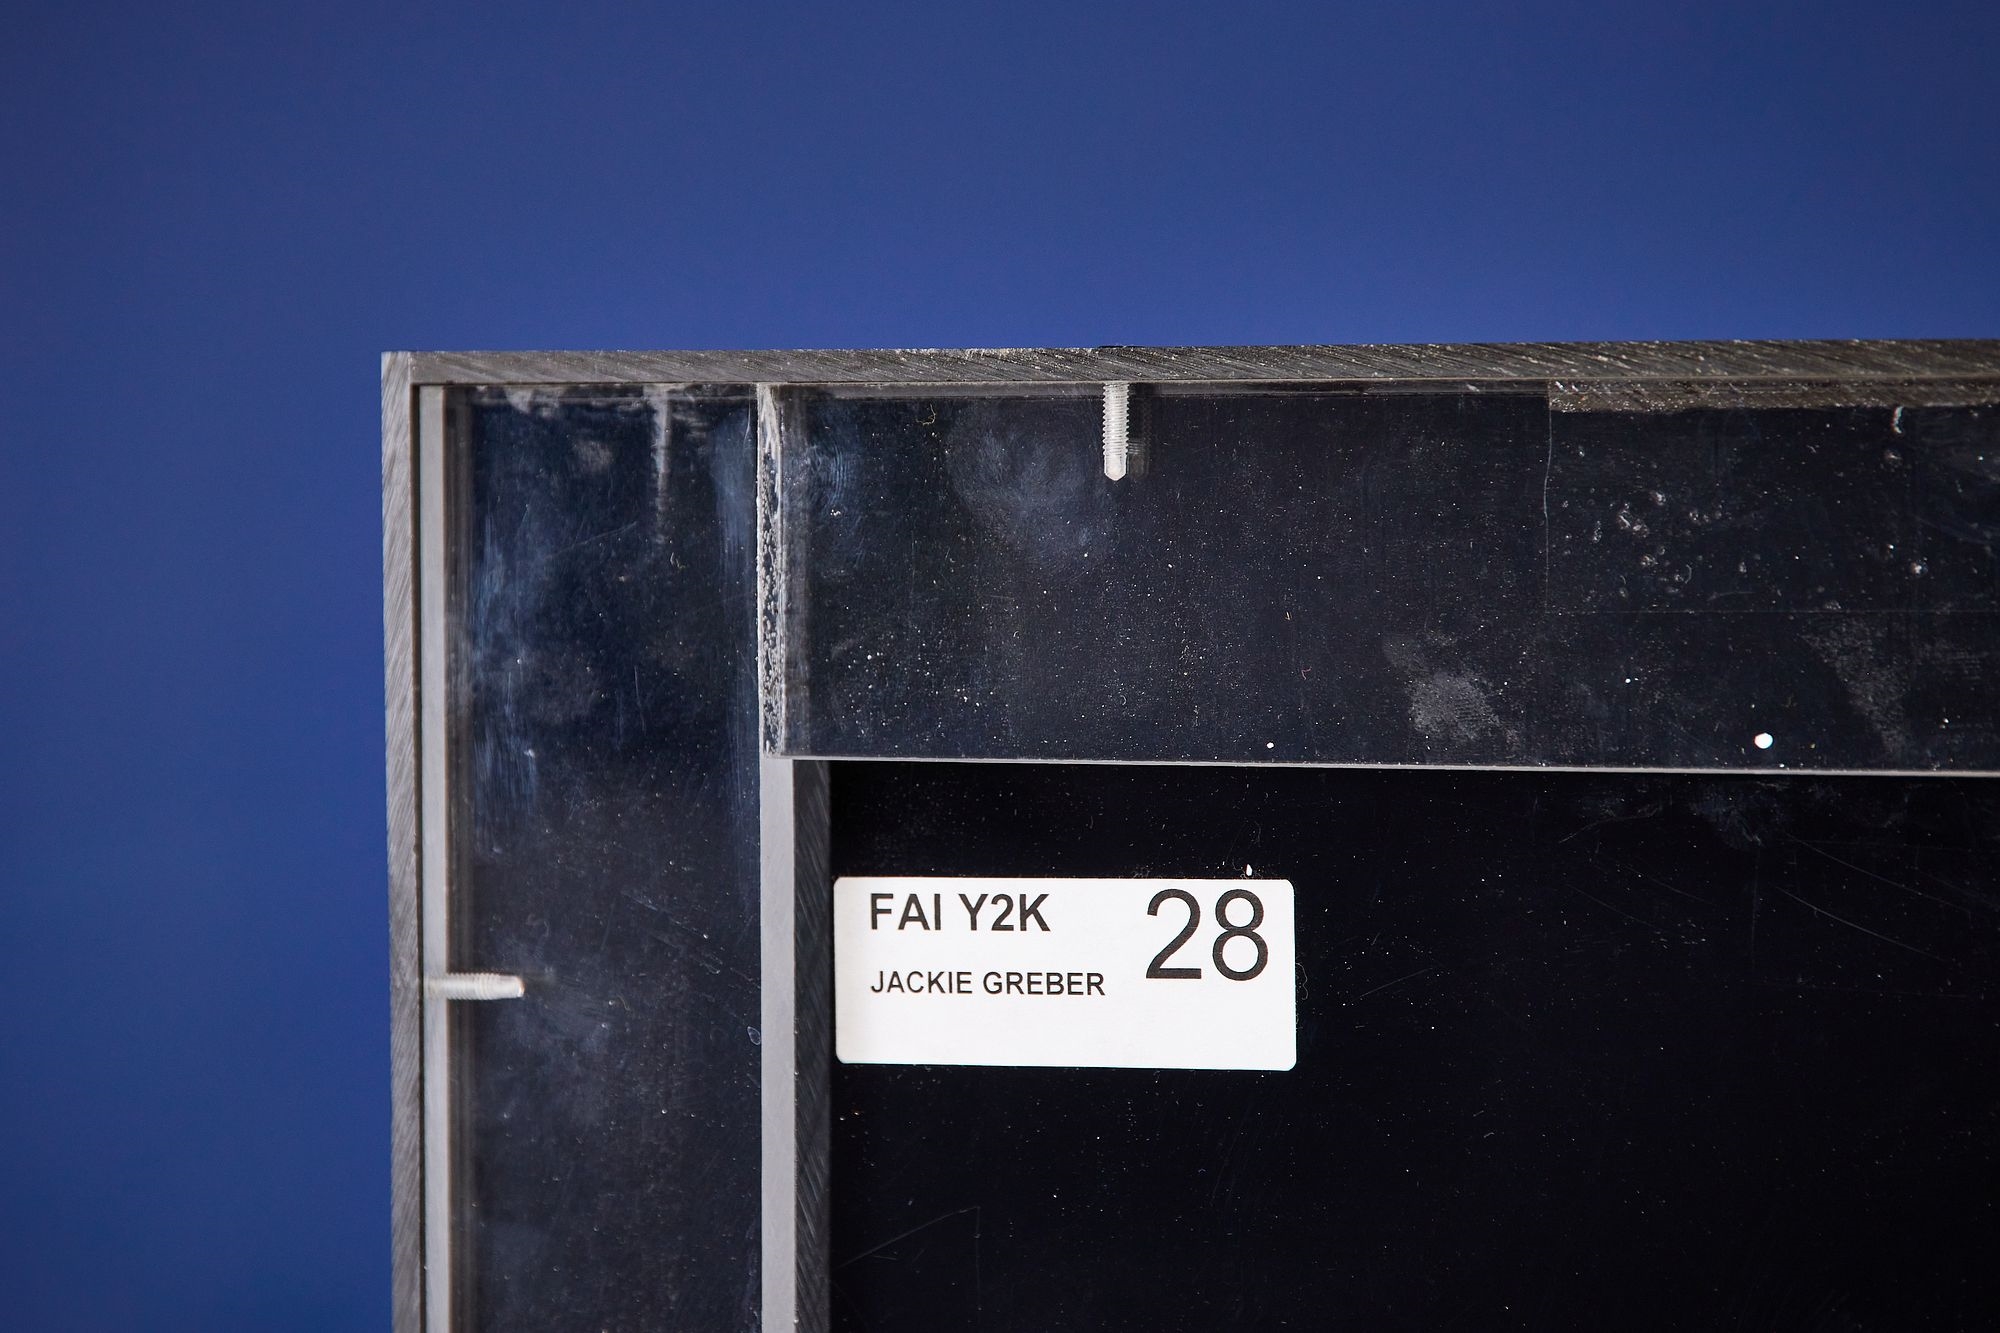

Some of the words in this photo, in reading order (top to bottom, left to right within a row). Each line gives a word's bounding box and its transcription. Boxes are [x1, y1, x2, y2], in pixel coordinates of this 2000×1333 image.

[870, 892, 942, 931] FAI
[958, 893, 1051, 932] Y2K
[1145, 888, 1269, 982] 28
[870, 970, 973, 994] JACKIE
[982, 971, 1106, 996] GREBER
